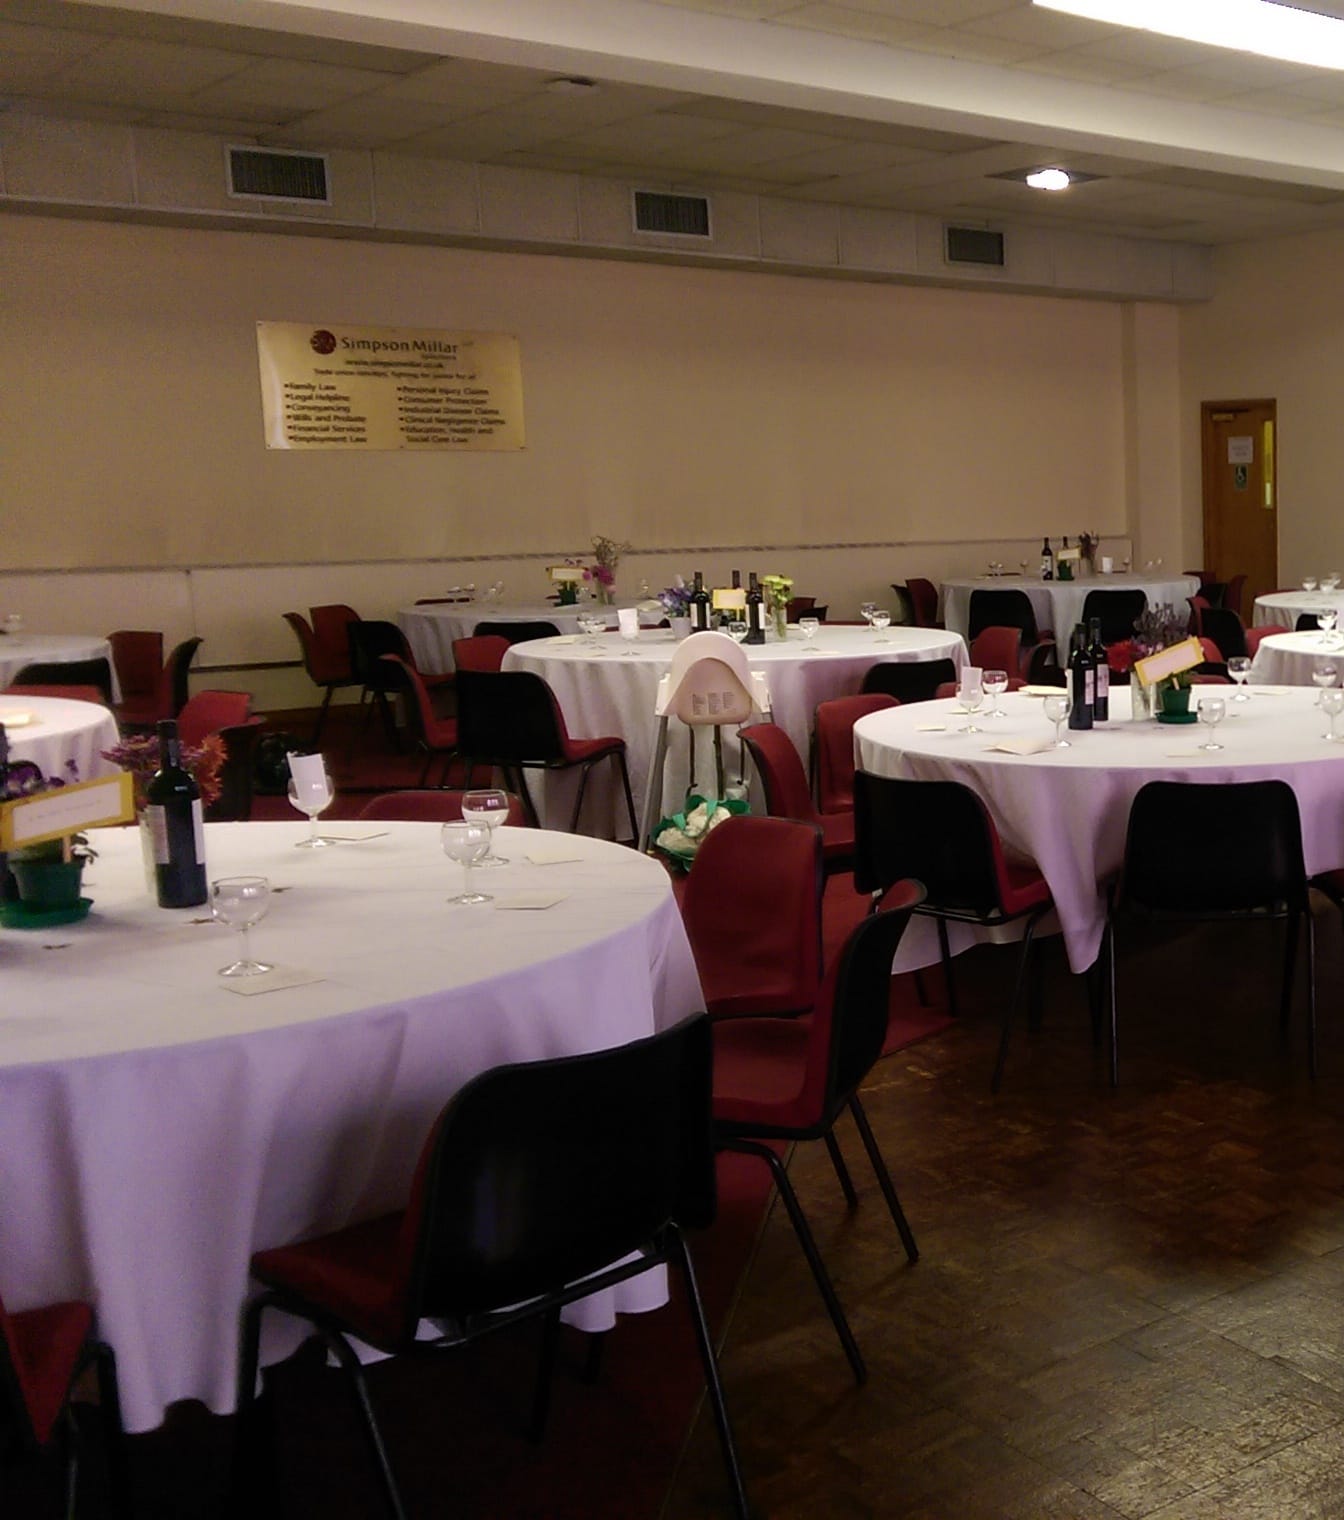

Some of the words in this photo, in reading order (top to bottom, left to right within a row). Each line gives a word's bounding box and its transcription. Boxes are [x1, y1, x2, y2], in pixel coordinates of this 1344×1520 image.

[341, 337, 409, 354] Simpson
[412, 339, 459, 354] Millar
[289, 382, 316, 392] Family
[290, 393, 314, 403] Legal
